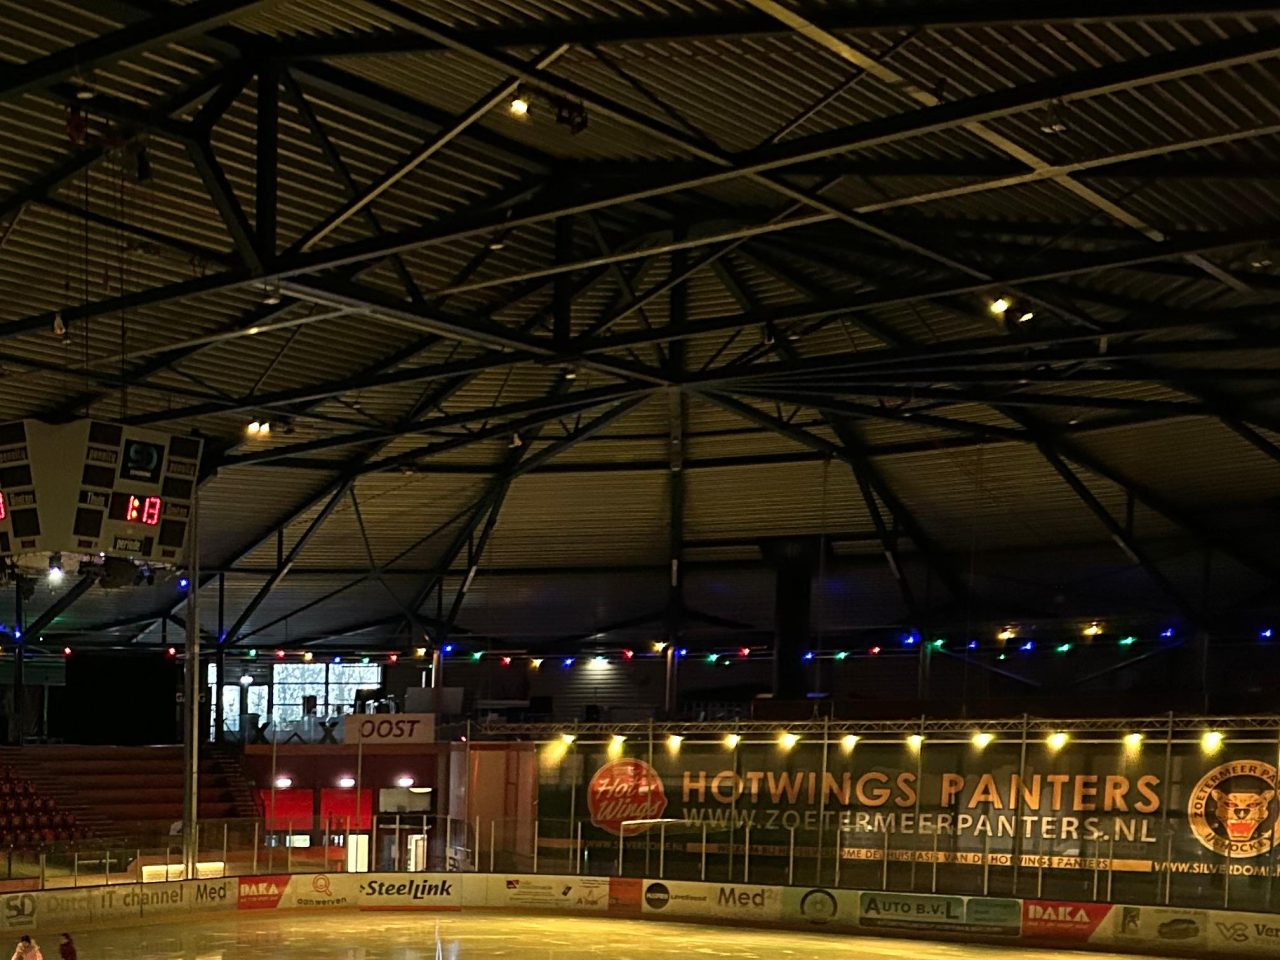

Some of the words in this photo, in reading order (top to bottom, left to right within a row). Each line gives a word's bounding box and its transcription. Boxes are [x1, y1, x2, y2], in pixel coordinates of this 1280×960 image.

[360, 719, 420, 738] OOST
[682, 770, 917, 808] HOTWINGS
[940, 773, 1161, 814] PANTERS
[683, 808, 1157, 843] WWW.ZOETERMEERPANTERS.NL
[123, 883, 184, 907] channel
[240, 882, 279, 897] DAKA
[1027, 904, 1091, 922] DAKA
